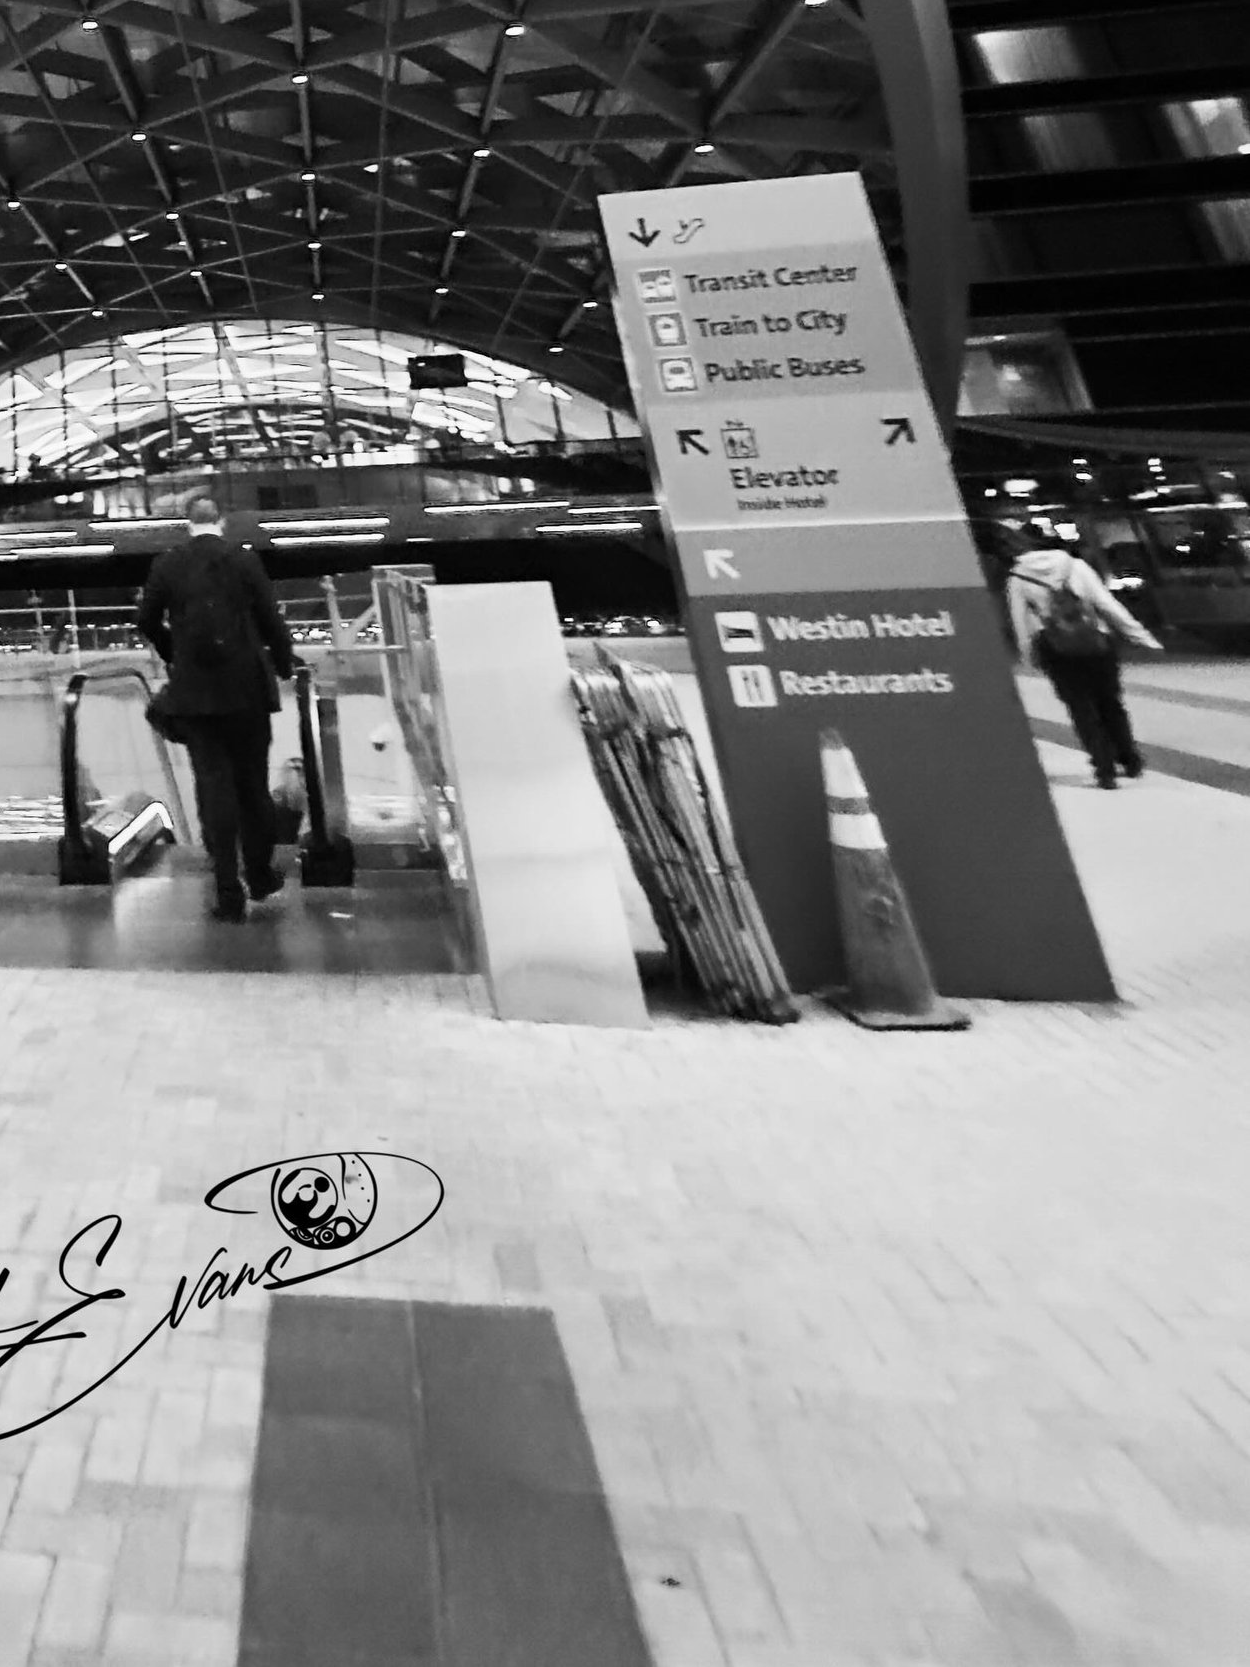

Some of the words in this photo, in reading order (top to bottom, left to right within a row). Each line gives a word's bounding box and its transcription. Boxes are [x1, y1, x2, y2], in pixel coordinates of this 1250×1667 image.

[683, 268, 768, 294] Transit
[773, 263, 858, 289] Center
[694, 315, 759, 337] Train
[764, 313, 792, 333] to
[795, 308, 848, 337] City
[704, 359, 783, 384] Public
[788, 356, 865, 378] Buses
[730, 466, 838, 490] Elevator
[738, 497, 782, 511] Inside
[785, 495, 826, 509] Hotel
[766, 614, 869, 642] Westin
[870, 610, 956, 638] Hotel
[779, 669, 954, 695] Restaurants
